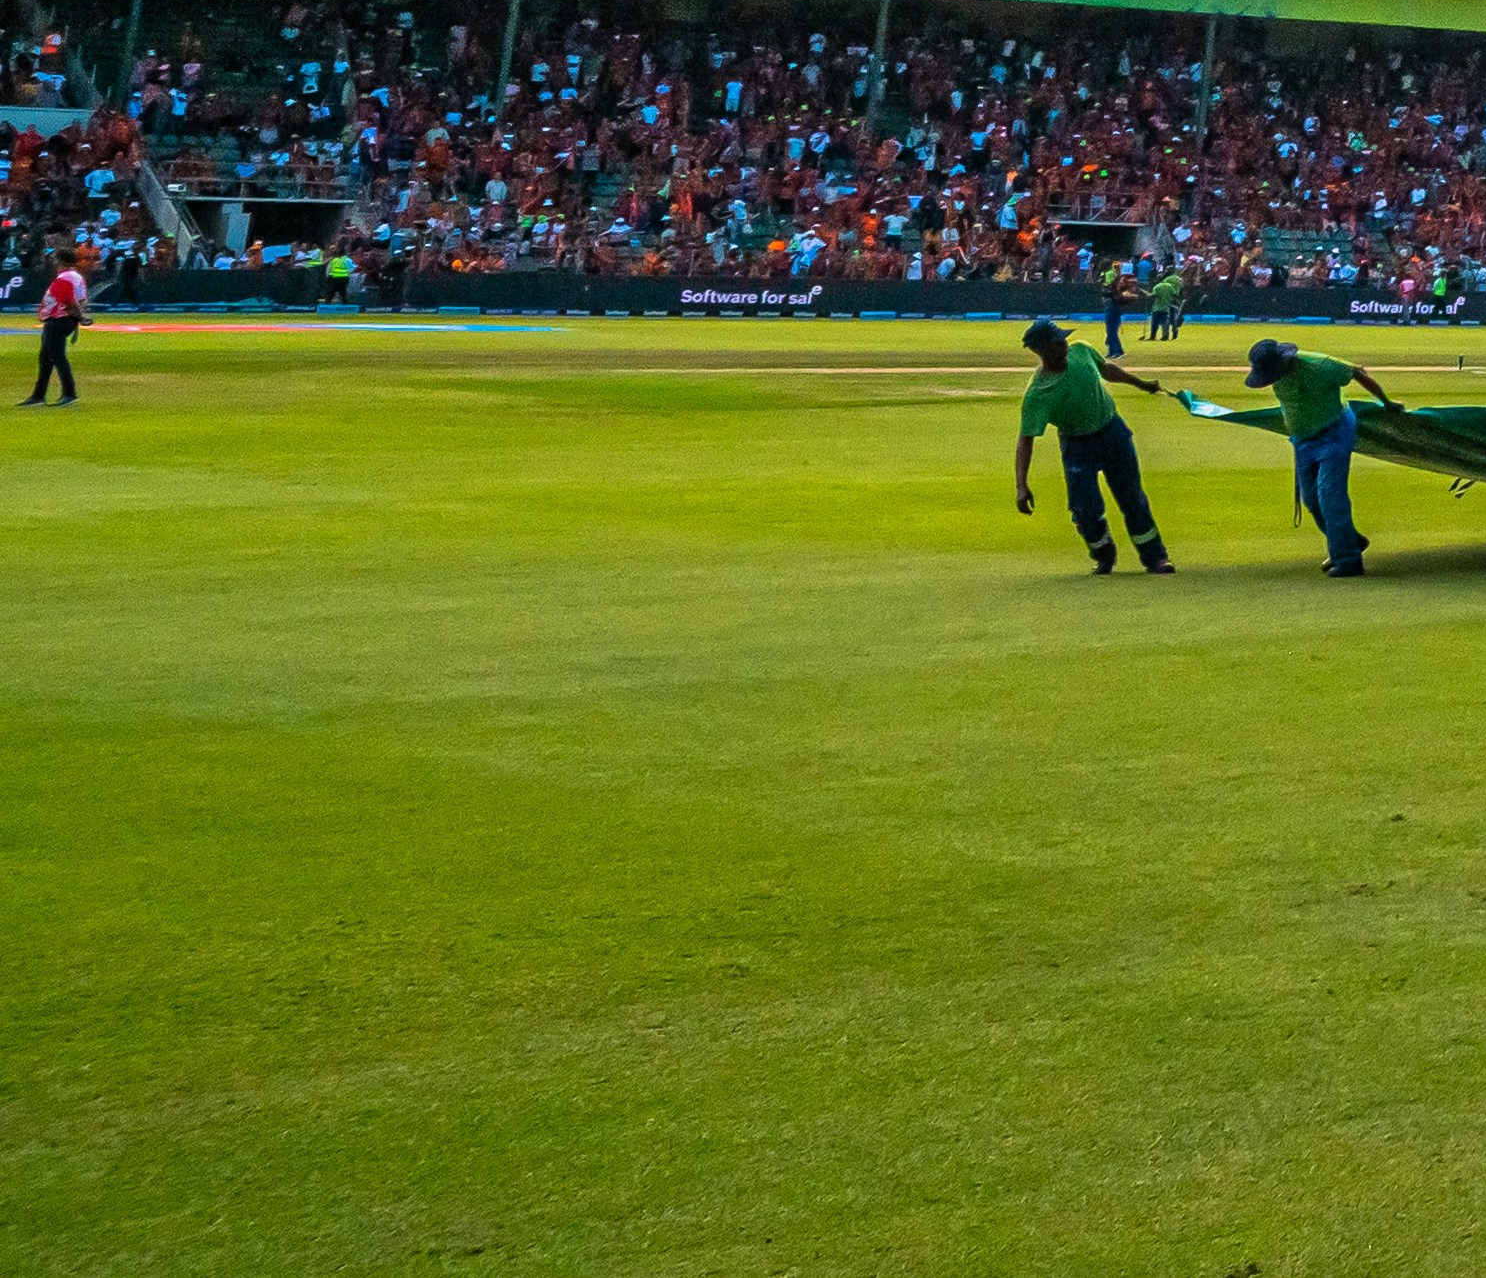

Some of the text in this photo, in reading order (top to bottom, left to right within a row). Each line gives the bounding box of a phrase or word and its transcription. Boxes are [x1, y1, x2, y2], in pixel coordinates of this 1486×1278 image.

[681, 285, 823, 305] Software for sale
[1416, 301, 1435, 314] for
